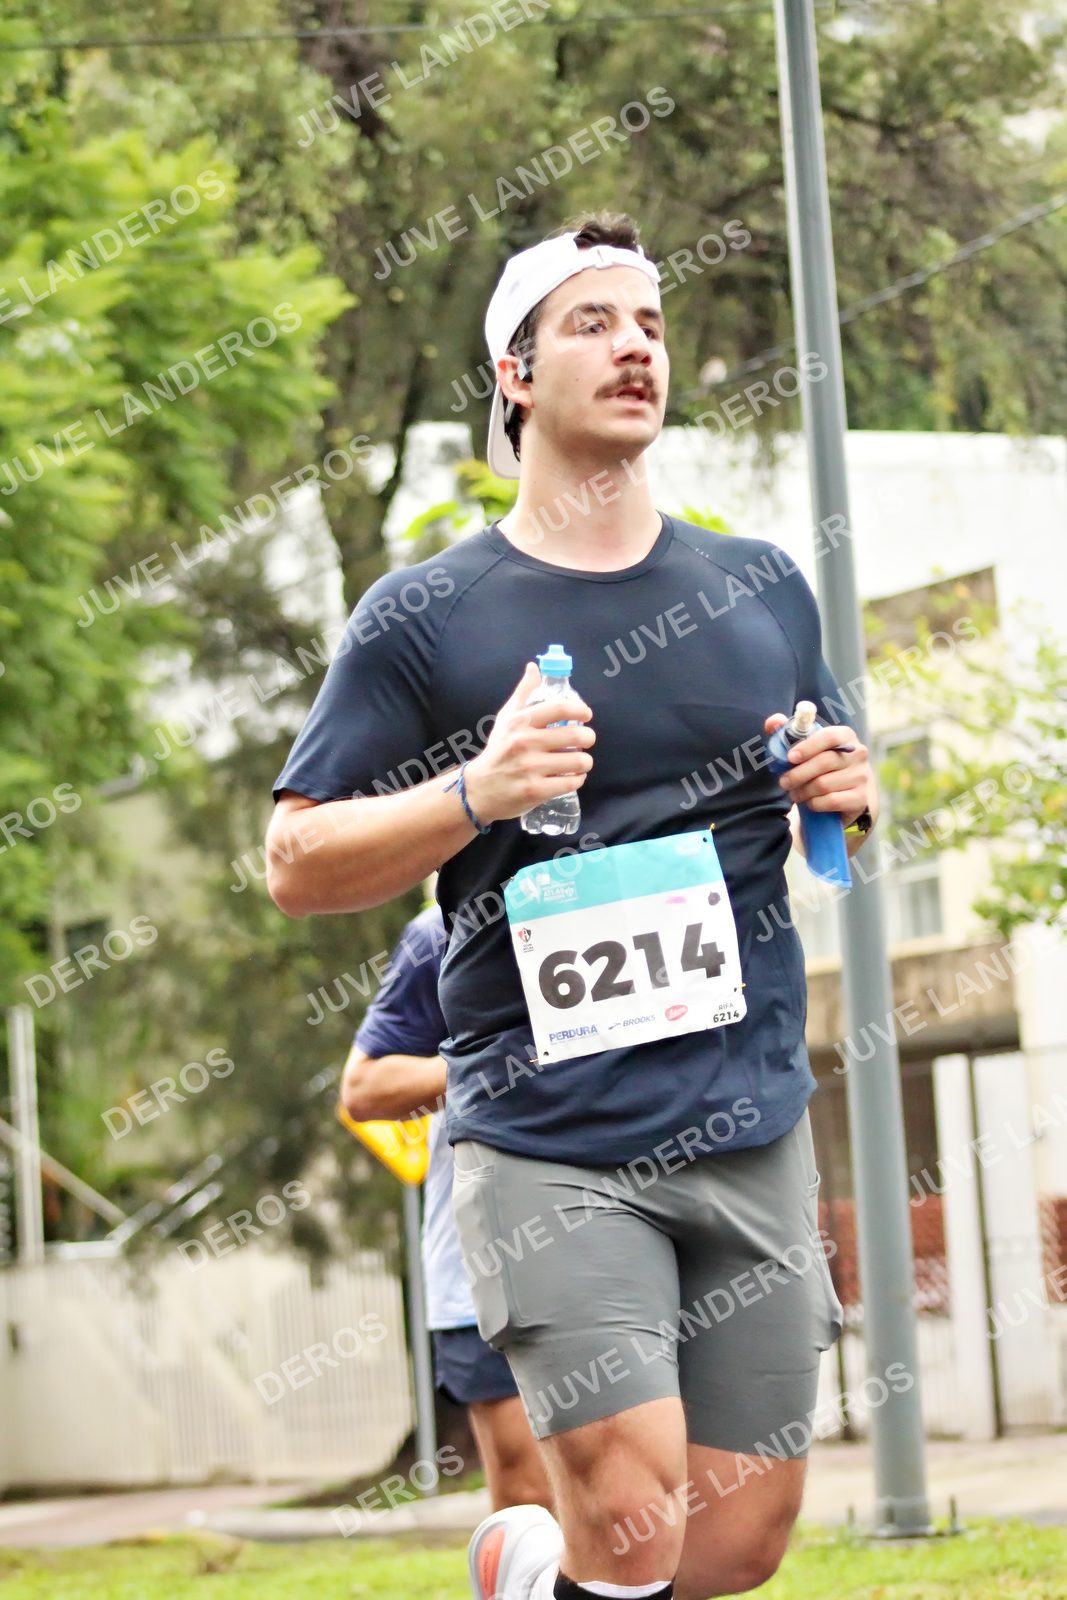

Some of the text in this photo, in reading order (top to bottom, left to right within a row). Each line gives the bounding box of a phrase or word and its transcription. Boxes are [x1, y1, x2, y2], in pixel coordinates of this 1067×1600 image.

[538, 922, 726, 1010] 6214
[622, 1014, 656, 1027] BROOKS
[713, 1010, 740, 1023] 6214
[549, 1024, 598, 1042] PERDURA
